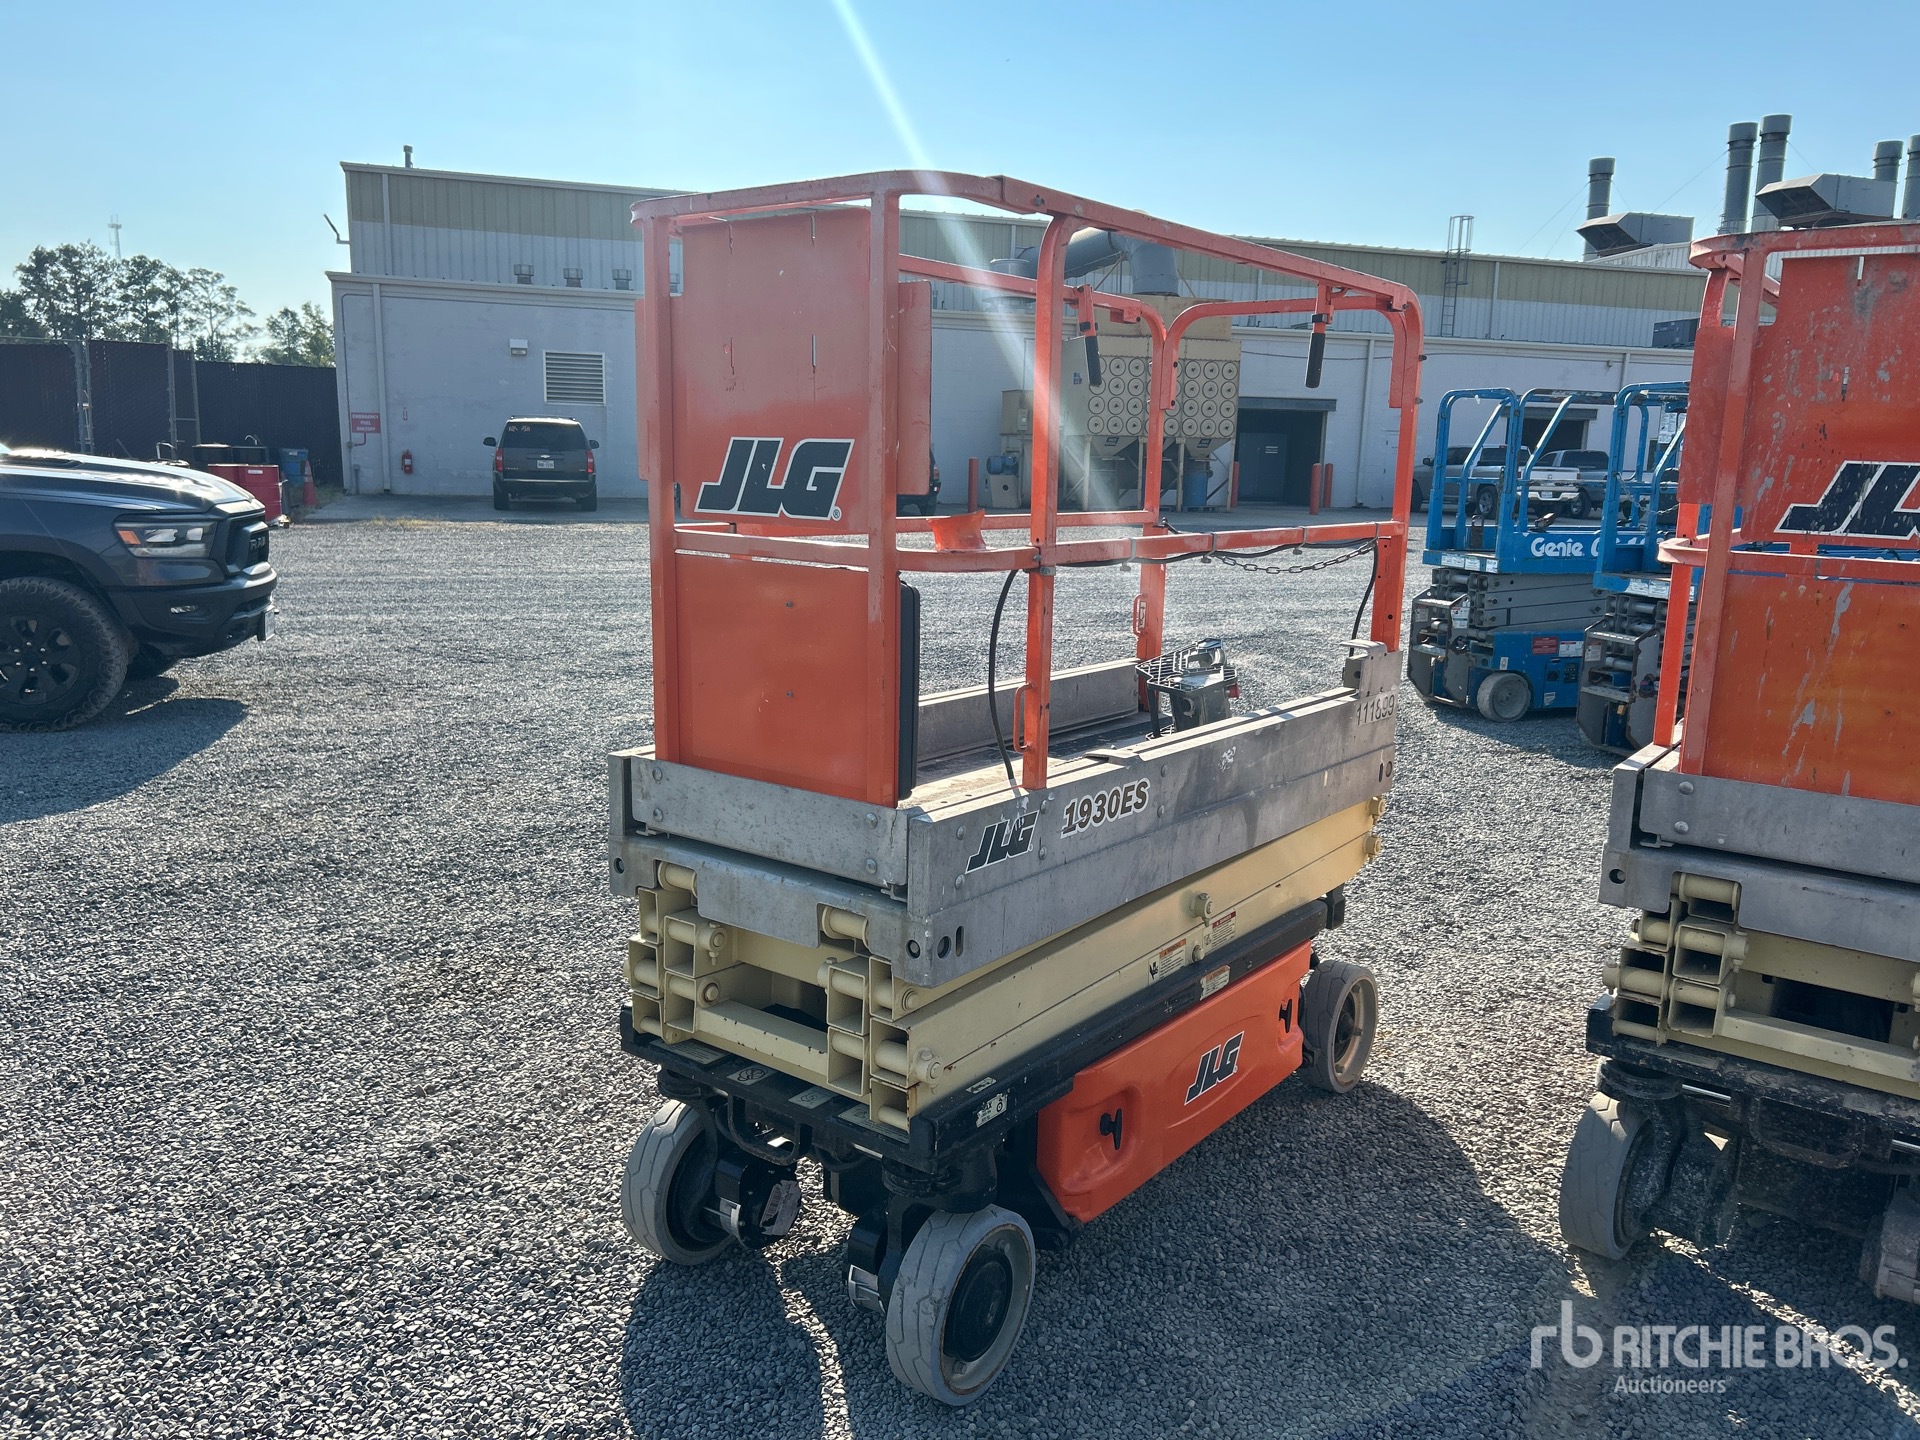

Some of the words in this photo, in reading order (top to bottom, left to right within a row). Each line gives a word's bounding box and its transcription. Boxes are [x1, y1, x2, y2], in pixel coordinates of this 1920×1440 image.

[694, 436, 855, 520] JLG
[1773, 459, 1920, 541] JL
[1530, 537, 1584, 557] Genie
[965, 809, 1040, 875] JLG
[1060, 777, 1150, 839] 1930ES
[1184, 1030, 1245, 1106] JLG
